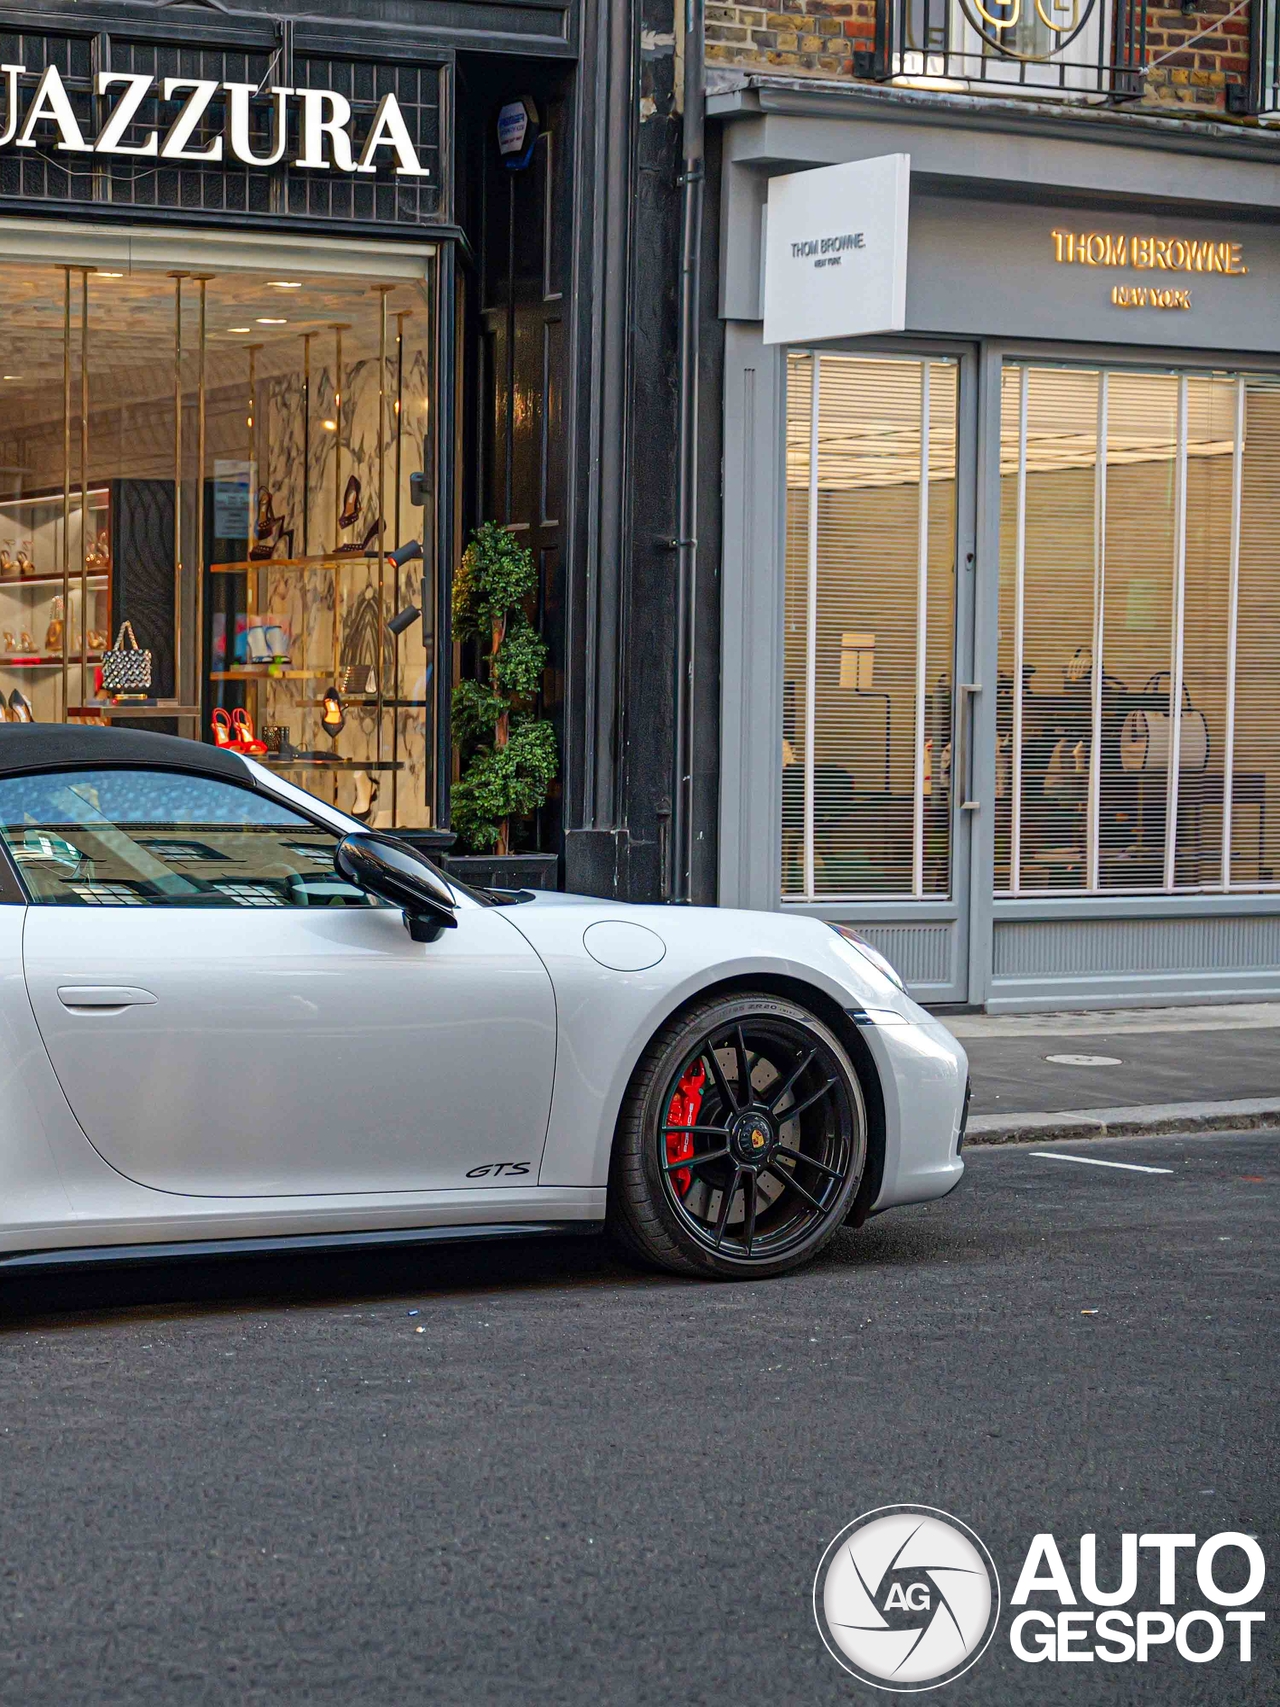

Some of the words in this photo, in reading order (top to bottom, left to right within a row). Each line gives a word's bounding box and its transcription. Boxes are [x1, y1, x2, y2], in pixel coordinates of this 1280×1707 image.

[791, 240, 818, 258] THOM
[1051, 230, 1128, 266] THOM
[1111, 285, 1148, 307] NEW
[1148, 287, 1192, 310] YORK
[466, 1162, 531, 1178] GTS
